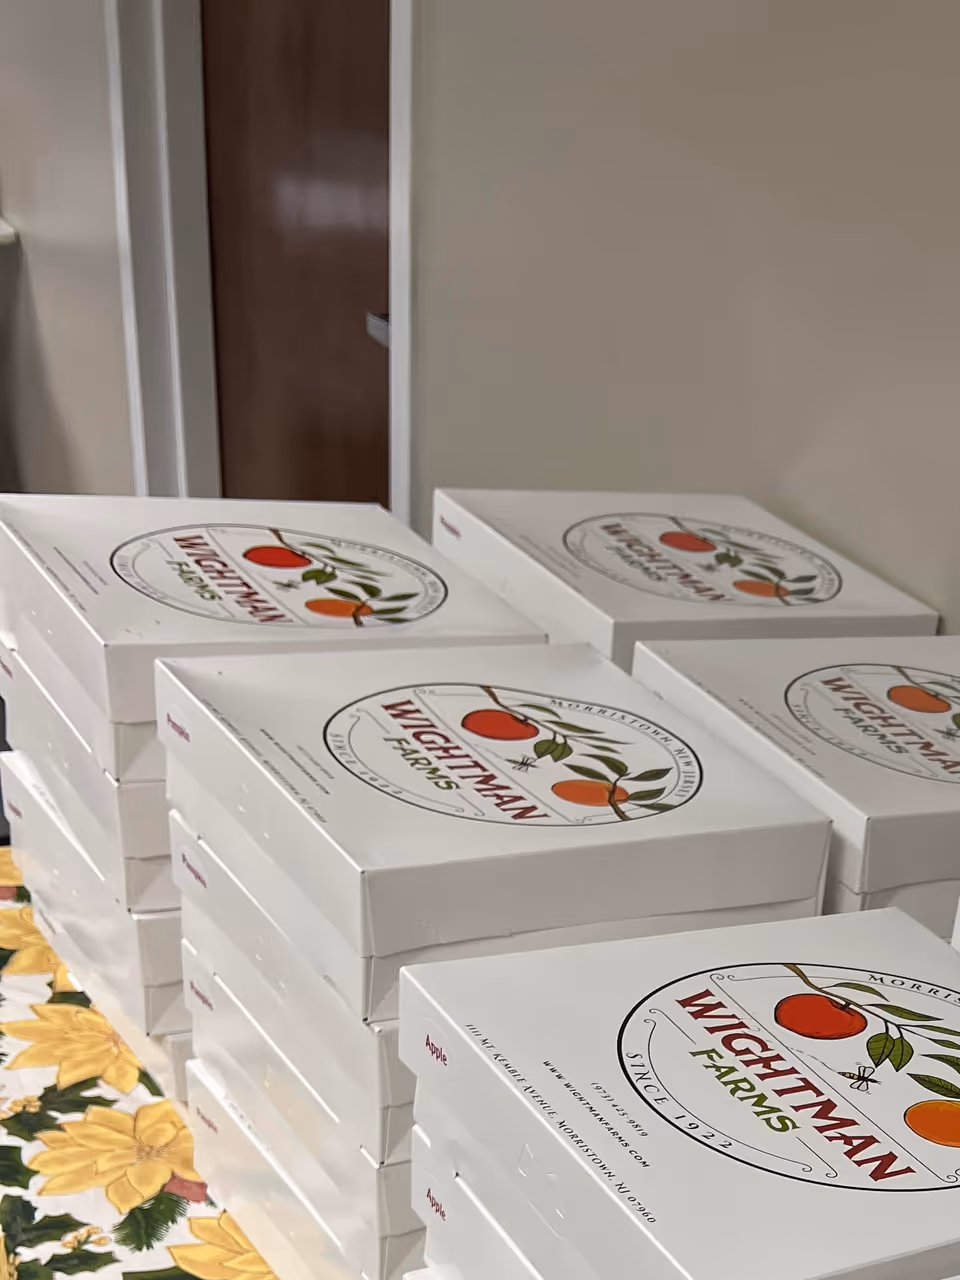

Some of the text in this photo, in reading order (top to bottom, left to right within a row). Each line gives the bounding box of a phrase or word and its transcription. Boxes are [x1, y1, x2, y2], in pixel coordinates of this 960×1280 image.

[172, 534, 294, 624] WIGHTMAN
[381, 699, 550, 821] WIGHTMAN
[383, 737, 461, 791] FARMS
[832, 706, 909, 755] FARMS
[425, 1034, 448, 1067] Apple
[675, 988, 916, 1183] WIGHTMAN
[689, 1047, 802, 1135] FARMS
[465, 1024, 657, 1224] 1111 MT. KEMBLE AVENUE, MORRISTOWN, NJ 07960
[591, 1082, 649, 1138] (973) 425-9819
[626, 1051, 734, 1149] SINCE 1922
[427, 1188, 446, 1222] Apple
